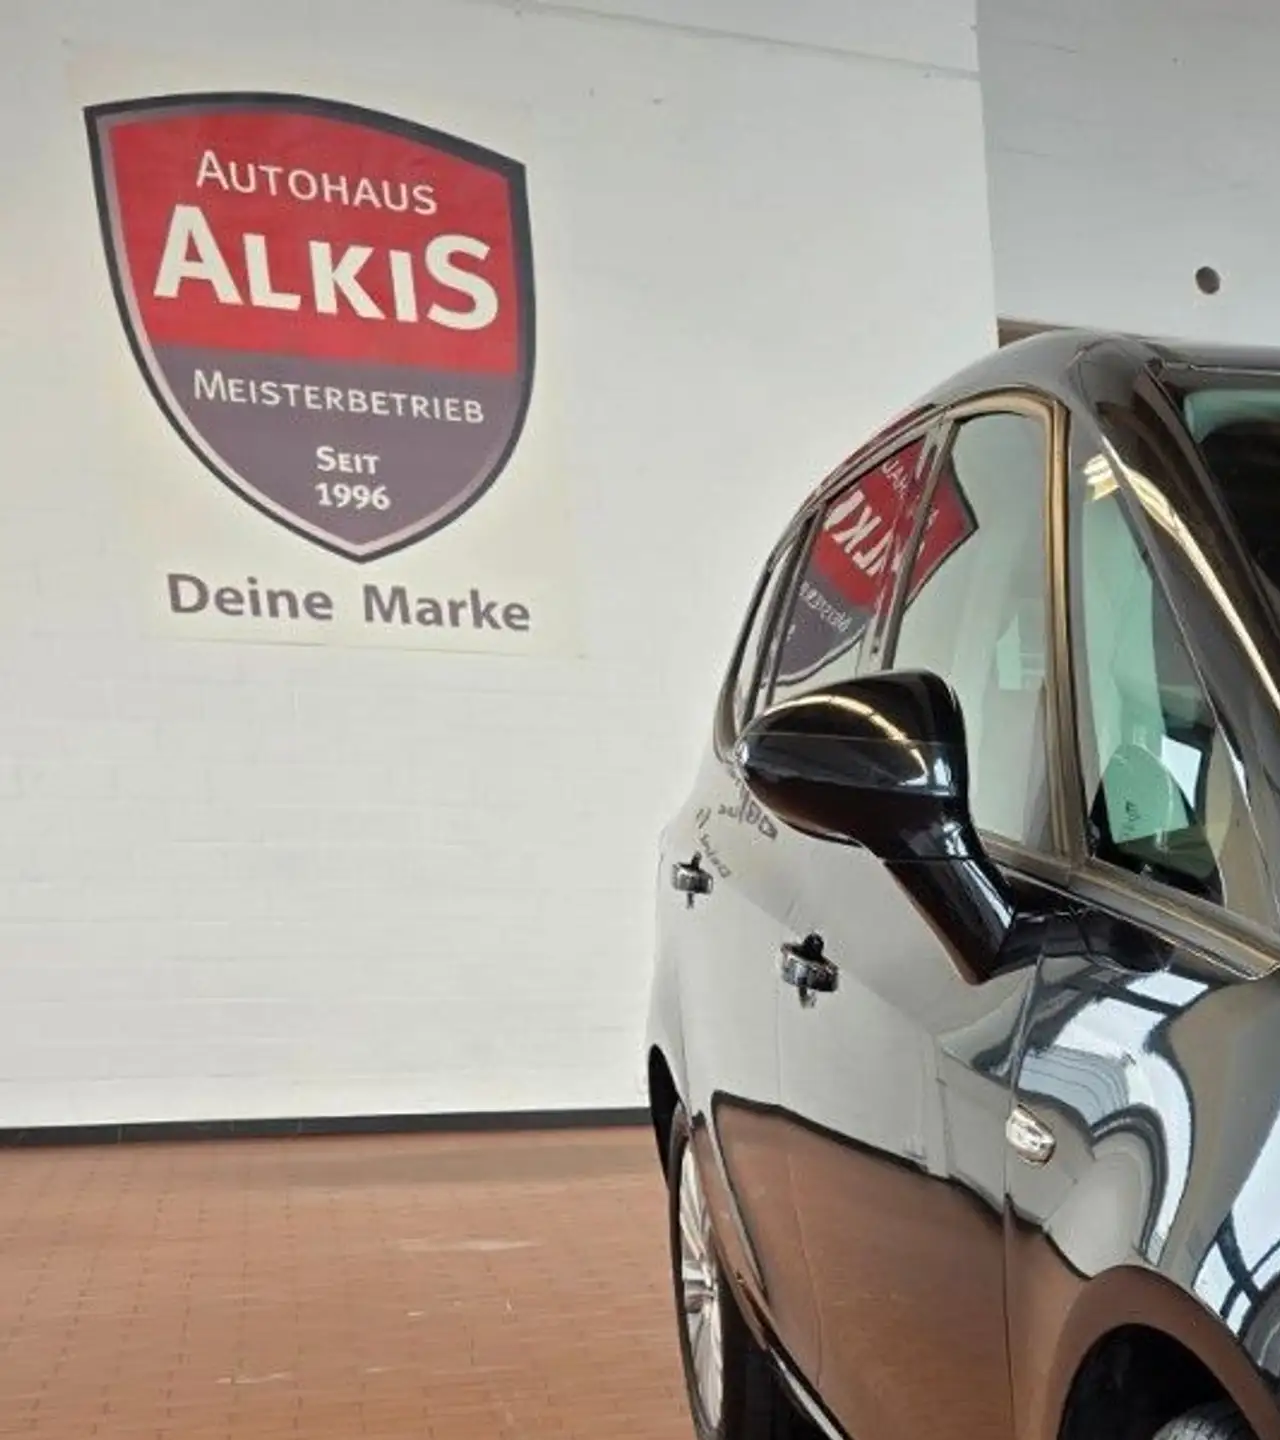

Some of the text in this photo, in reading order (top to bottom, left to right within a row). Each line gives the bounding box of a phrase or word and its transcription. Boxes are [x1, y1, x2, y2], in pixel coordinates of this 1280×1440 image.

[196, 150, 437, 216] AUTOHAUS
[153, 203, 499, 331] ALKIS
[193, 369, 485, 423] MEISTERBETRIEB
[315, 445, 380, 475] SEIT
[314, 481, 391, 511] 1996
[166, 572, 531, 632] Deine Marke
